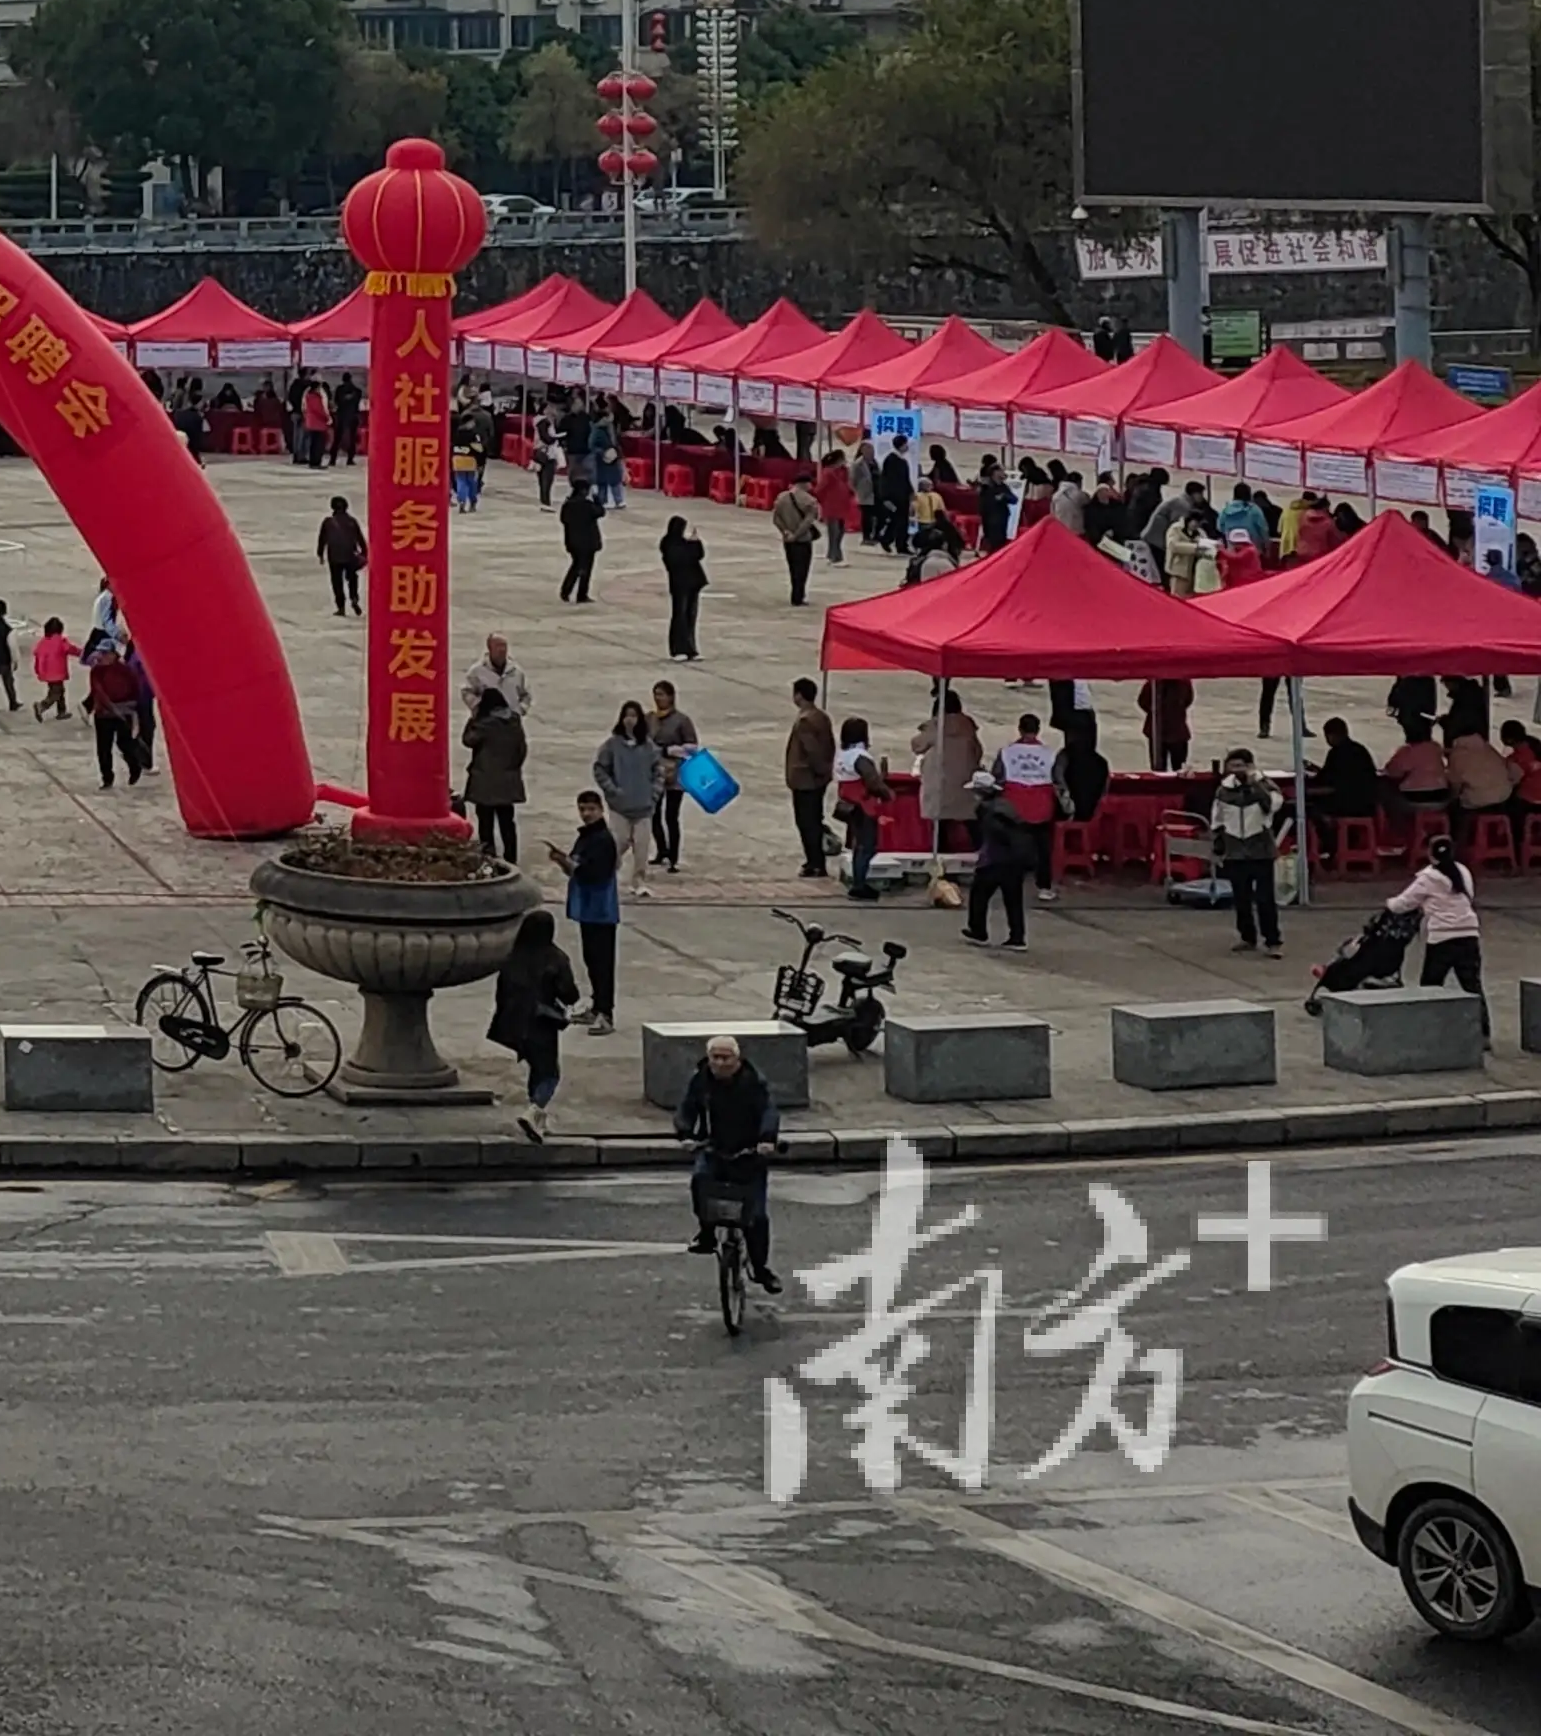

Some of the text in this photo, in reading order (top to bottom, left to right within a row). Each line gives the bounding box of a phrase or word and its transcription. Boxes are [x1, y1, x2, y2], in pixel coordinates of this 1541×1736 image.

[388, 308, 442, 744] 人社服务助发展
